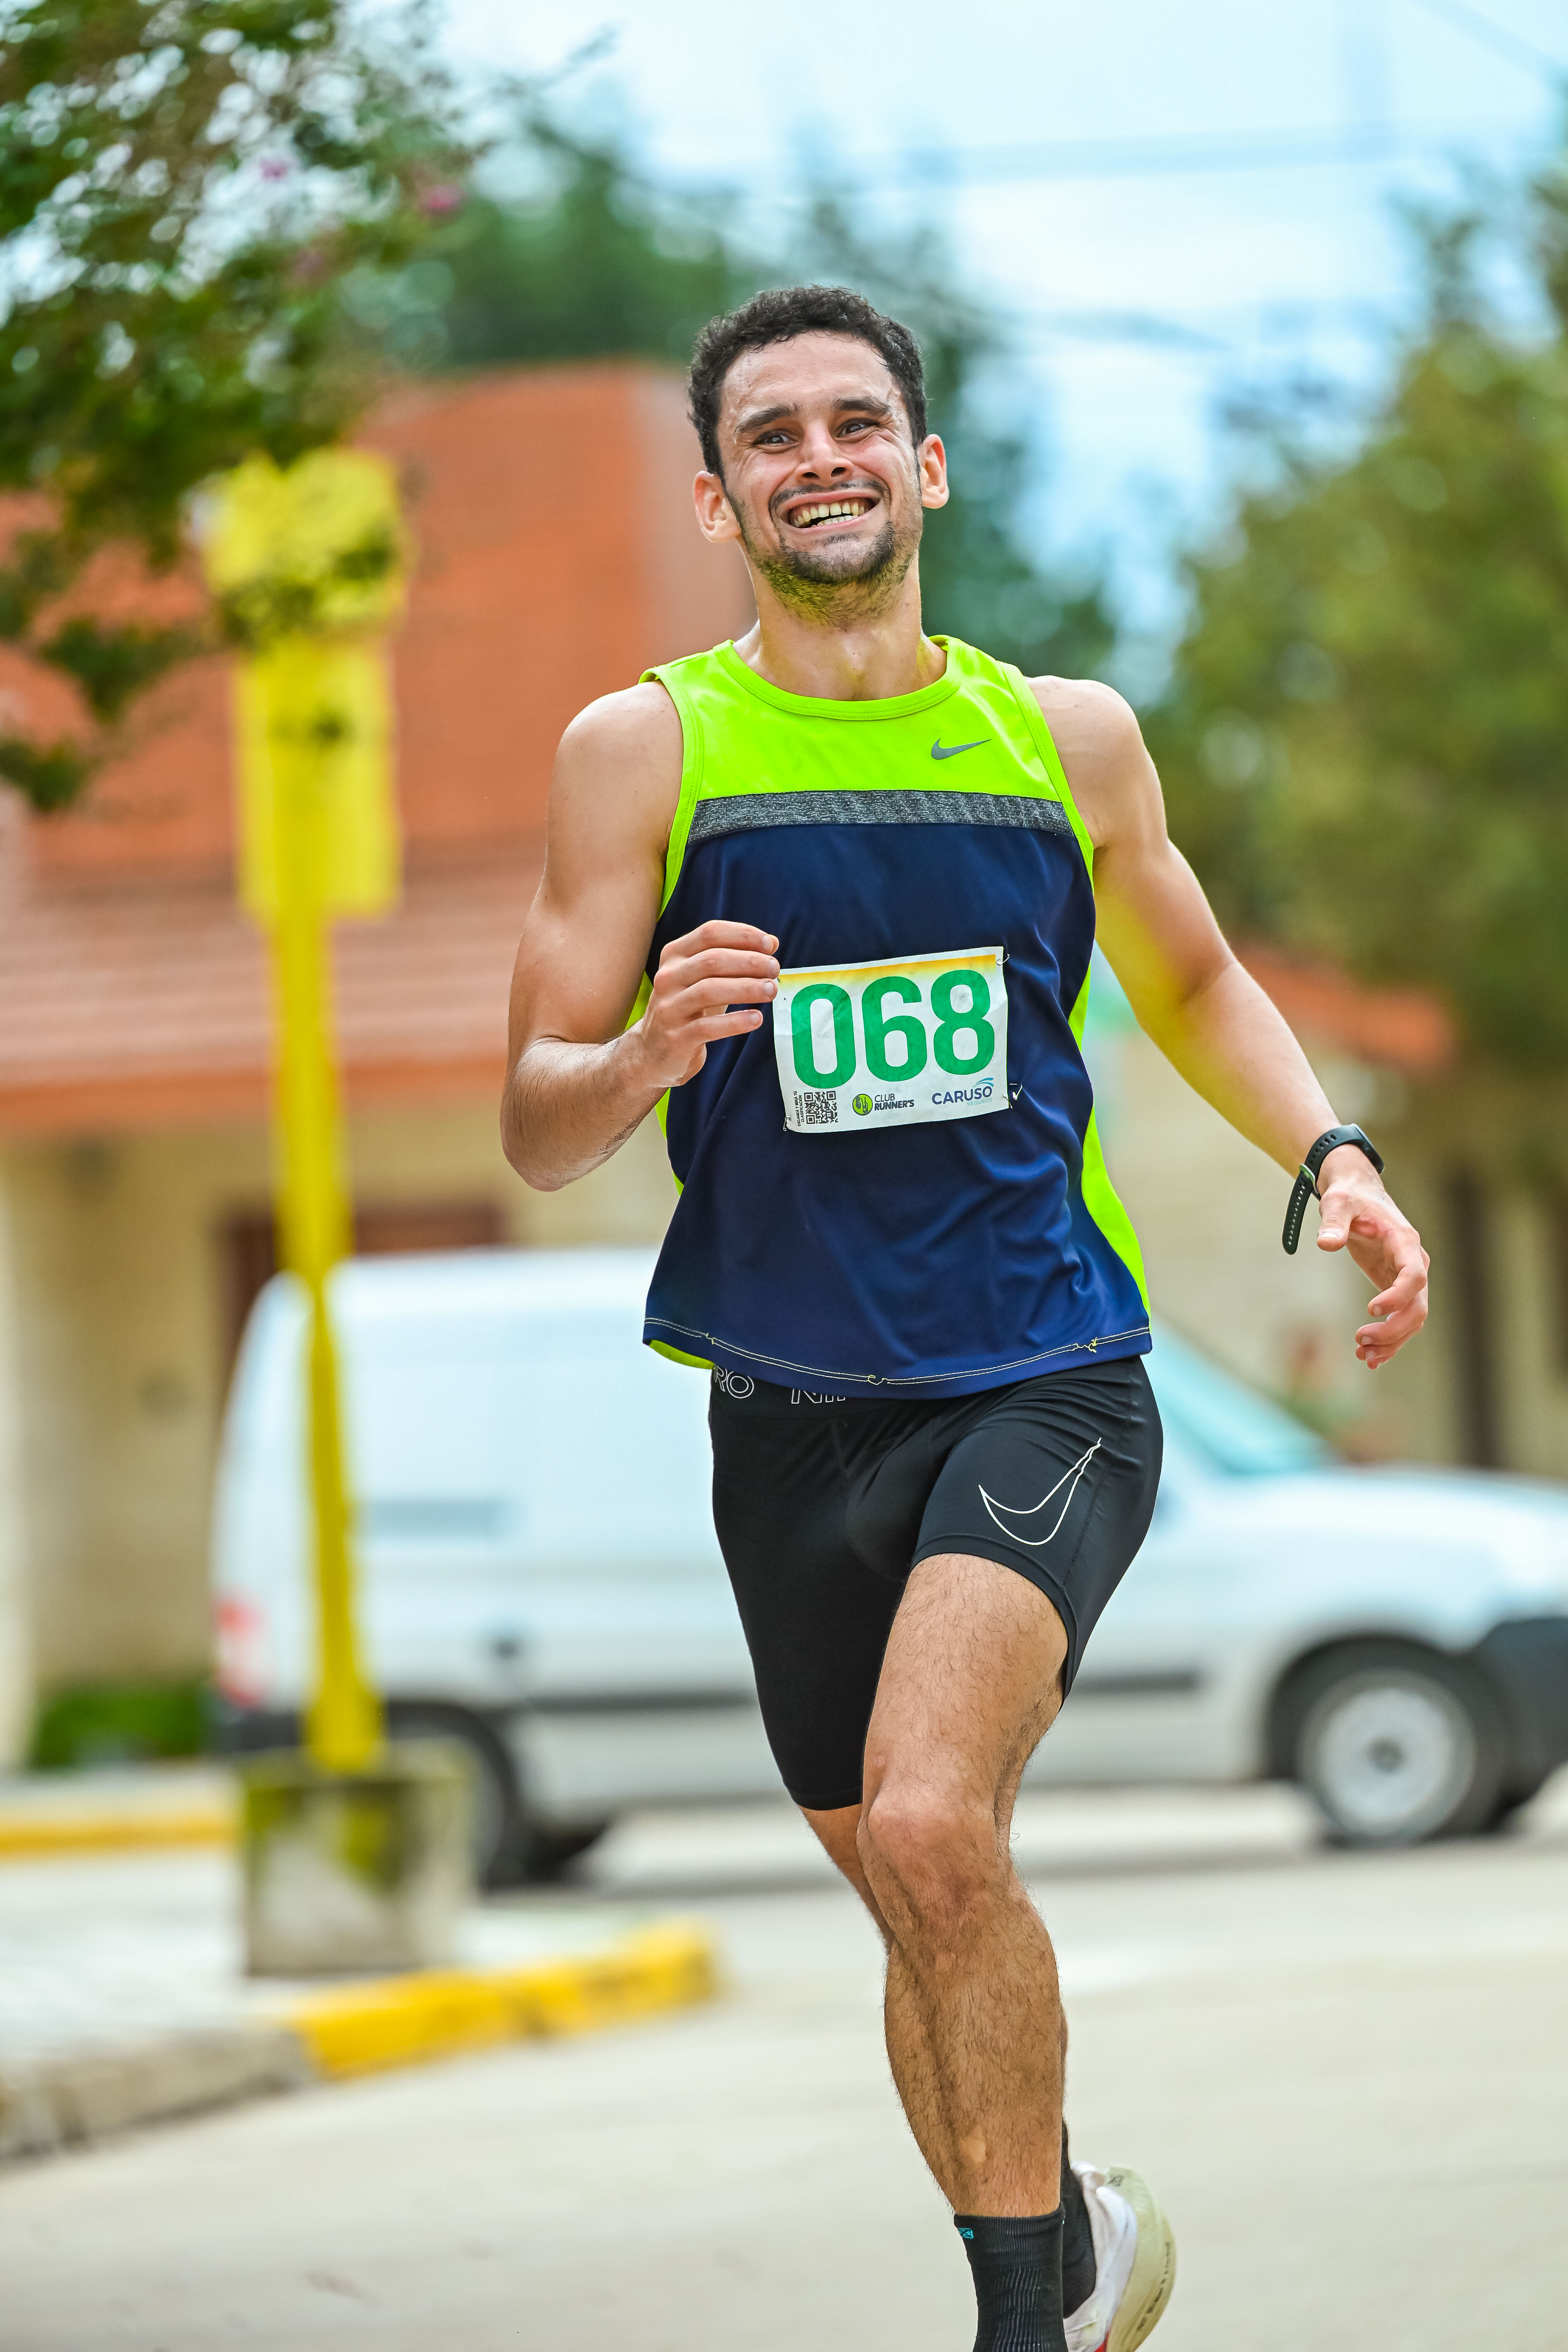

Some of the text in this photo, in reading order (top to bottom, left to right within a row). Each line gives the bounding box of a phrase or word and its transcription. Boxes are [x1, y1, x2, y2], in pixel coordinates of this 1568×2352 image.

[791, 970, 995, 1088] 068
[875, 1094, 895, 1102] CLUB
[932, 1086, 992, 1105] CARUSO
[874, 1100, 915, 1111] RUNNER'S
[967, 1098, 992, 1106] SEGUROS
